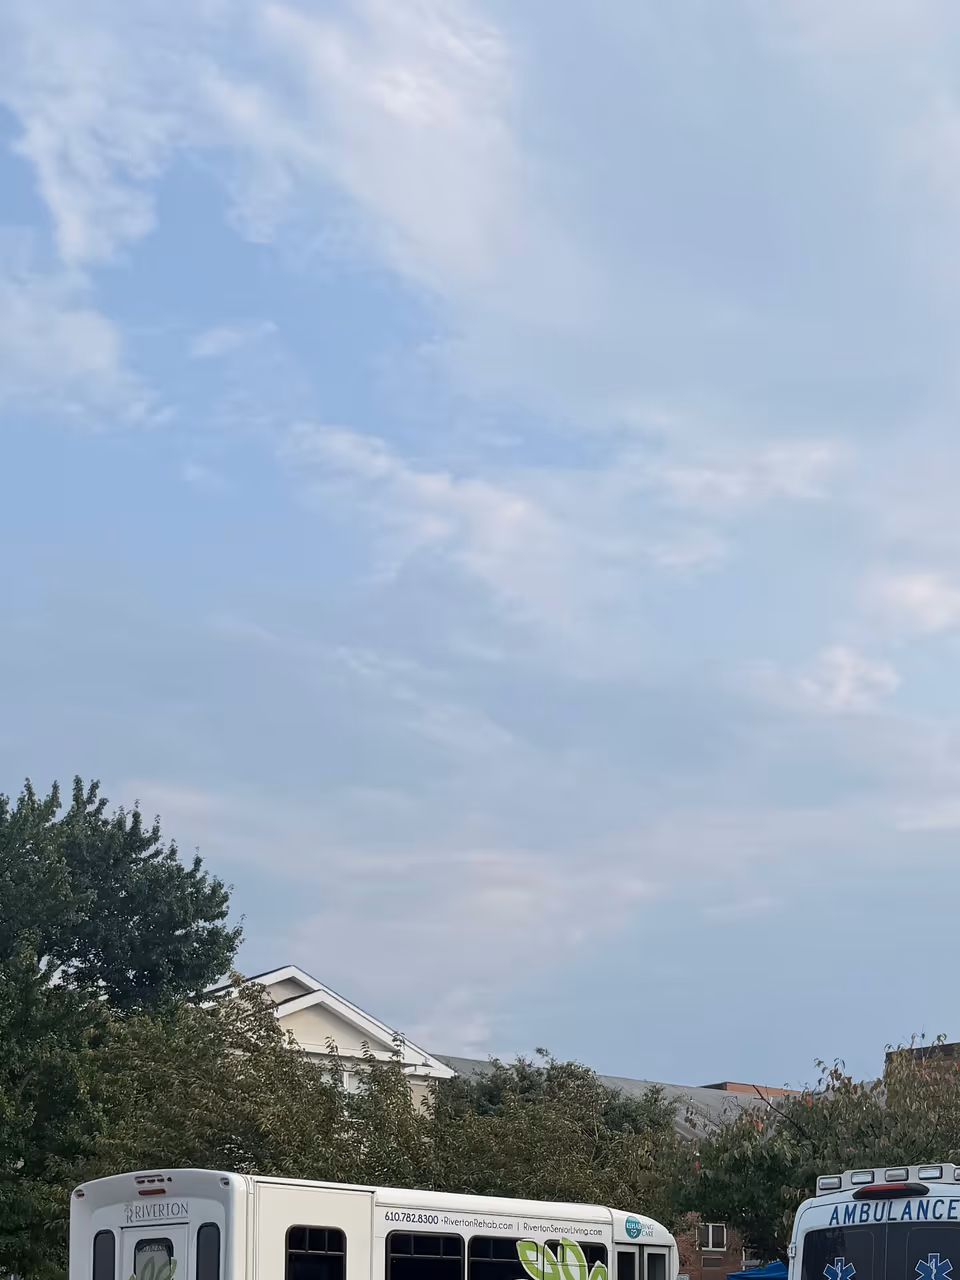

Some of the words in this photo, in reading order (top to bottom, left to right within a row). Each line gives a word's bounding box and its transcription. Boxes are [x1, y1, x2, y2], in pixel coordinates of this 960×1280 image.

[135, 1200, 189, 1219] RIVERTON
[829, 1198, 960, 1226] AMBULANCE
[384, 1211, 439, 1225] 610.782.8300
[523, 1222, 603, 1236] RivertonSeniorLiving.com
